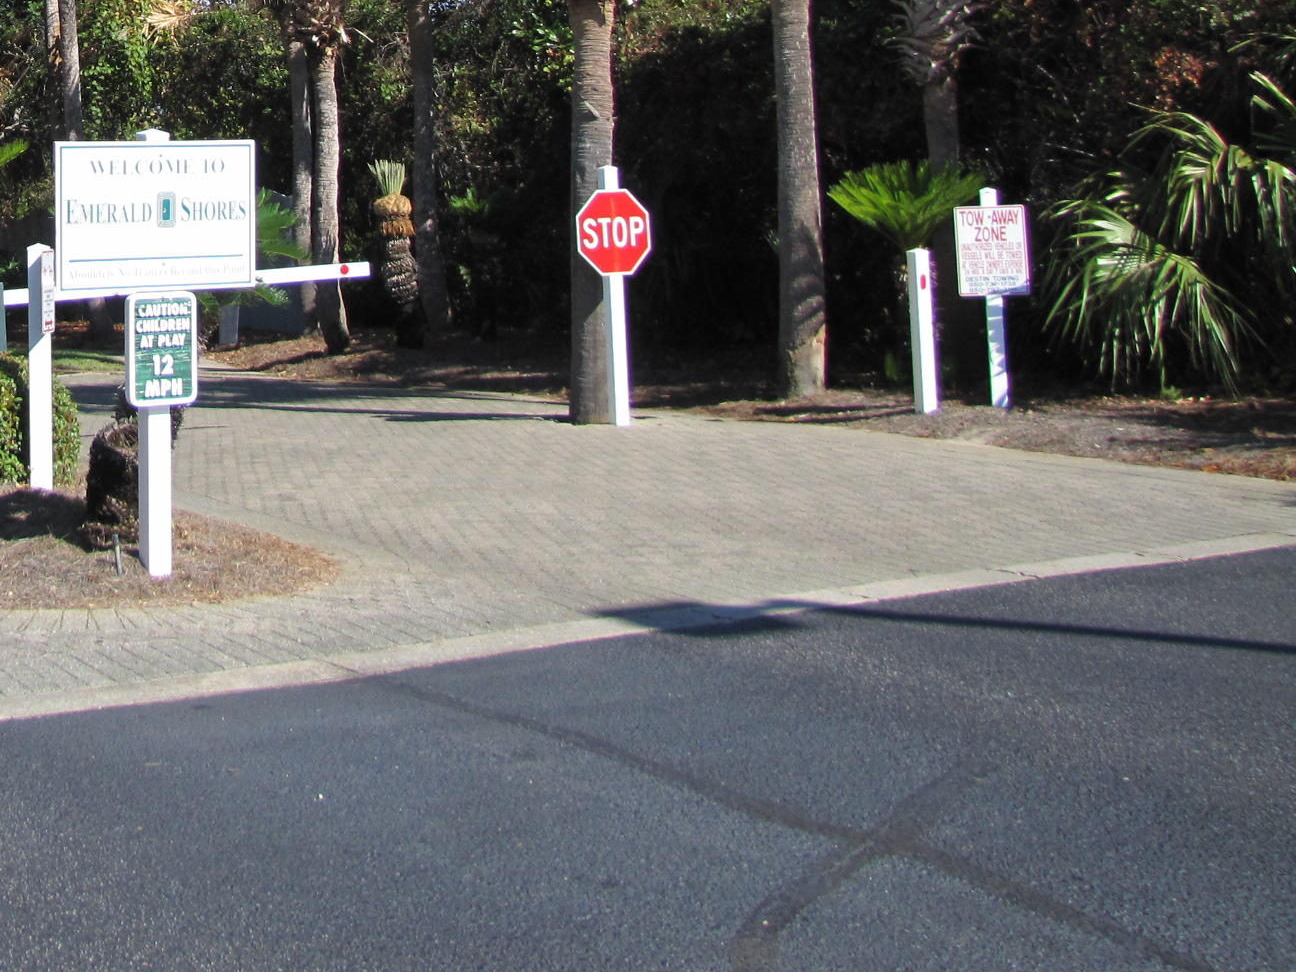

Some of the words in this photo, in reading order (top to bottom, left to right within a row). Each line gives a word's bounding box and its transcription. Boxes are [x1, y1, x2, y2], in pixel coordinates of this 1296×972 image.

[90, 159, 193, 176] WELCOME
[199, 158, 225, 174] TO
[66, 199, 152, 225] EMERALD
[181, 196, 246, 222] SHORES
[959, 210, 984, 226] TOW
[991, 210, 1018, 225] AWAY
[582, 216, 644, 249] STOP
[974, 226, 1007, 242] ZONE
[136, 317, 190, 332] CHILDREN
[140, 334, 154, 348] AT
[157, 332, 186, 347] PLAY
[152, 354, 174, 376] 12
[144, 377, 183, 398] MPH
